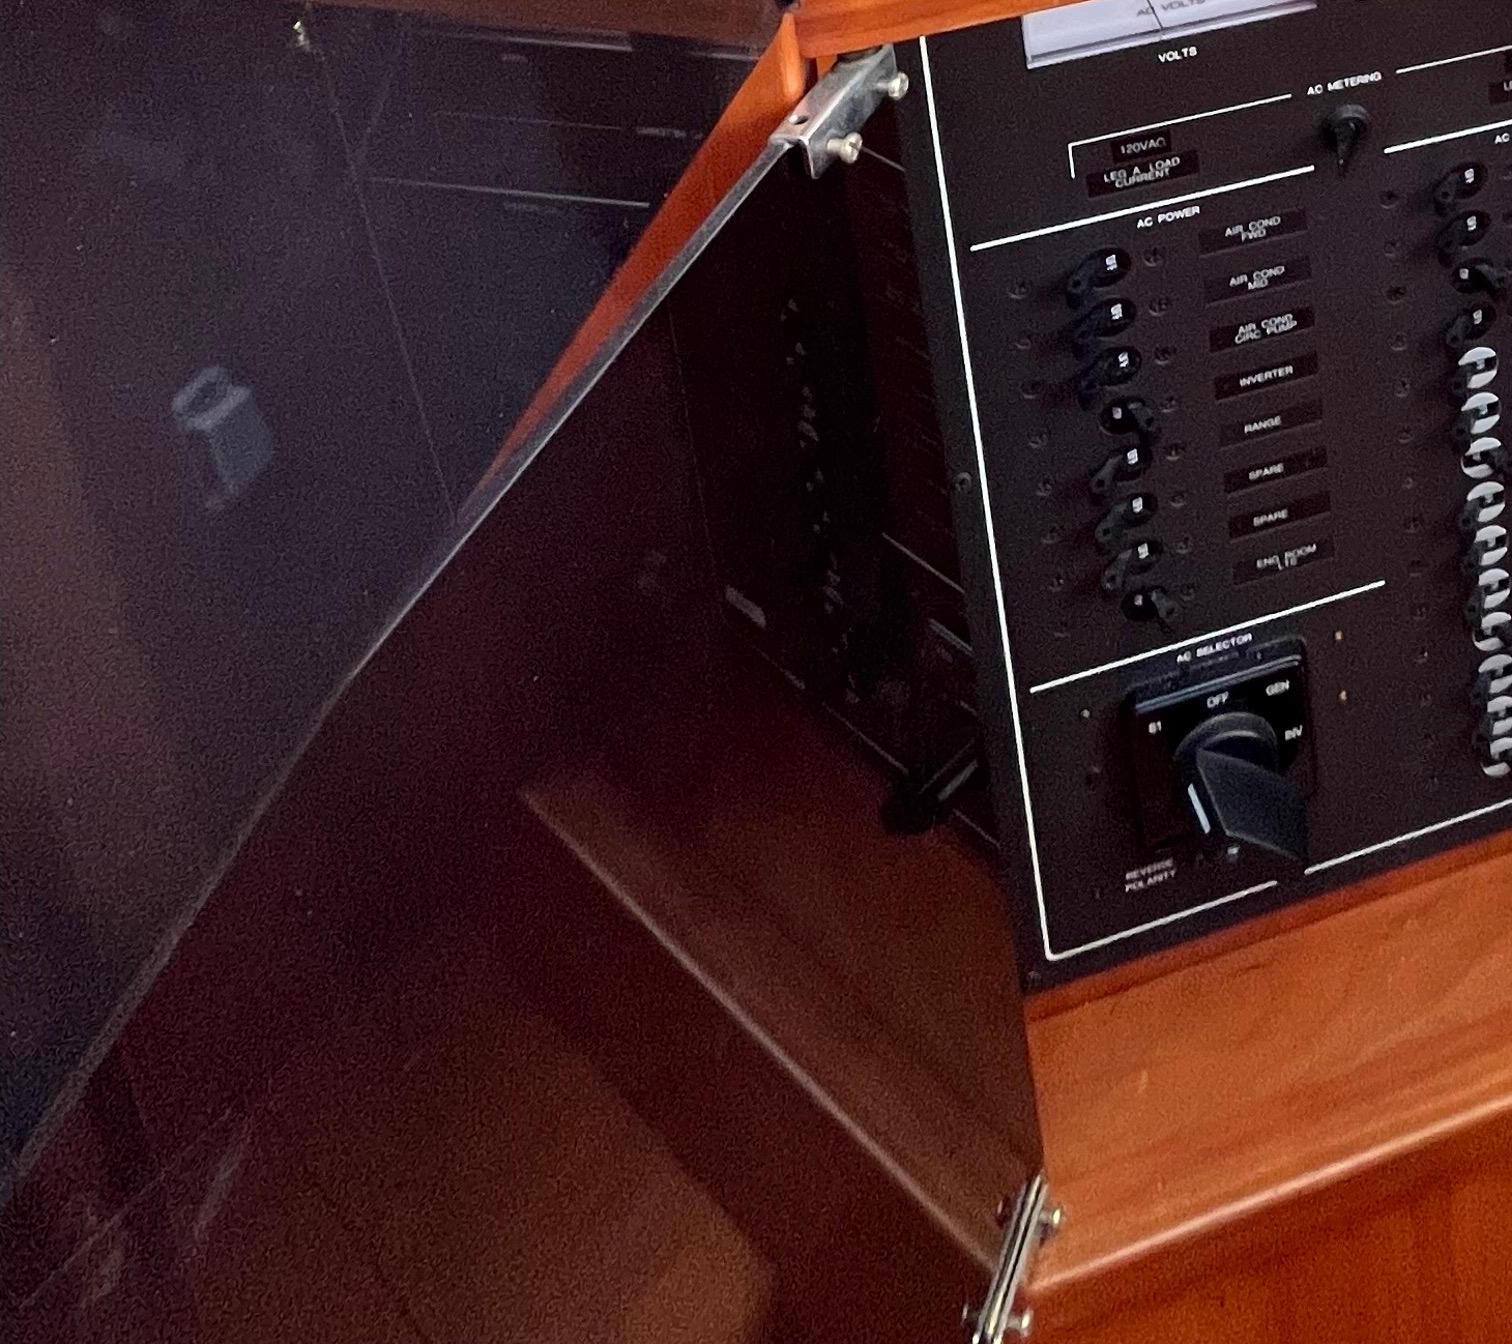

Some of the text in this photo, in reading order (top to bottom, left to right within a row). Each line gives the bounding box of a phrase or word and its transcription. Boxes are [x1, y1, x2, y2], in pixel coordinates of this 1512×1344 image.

[1158, 46, 1198, 63] VOLTS
[1307, 71, 1382, 95] AC METERING
[1494, 133, 1510, 144] AC
[1136, 205, 1201, 230] AC POWER
[1239, 365, 1294, 387] INVERTER
[1196, 633, 1252, 658] SELECTOR
